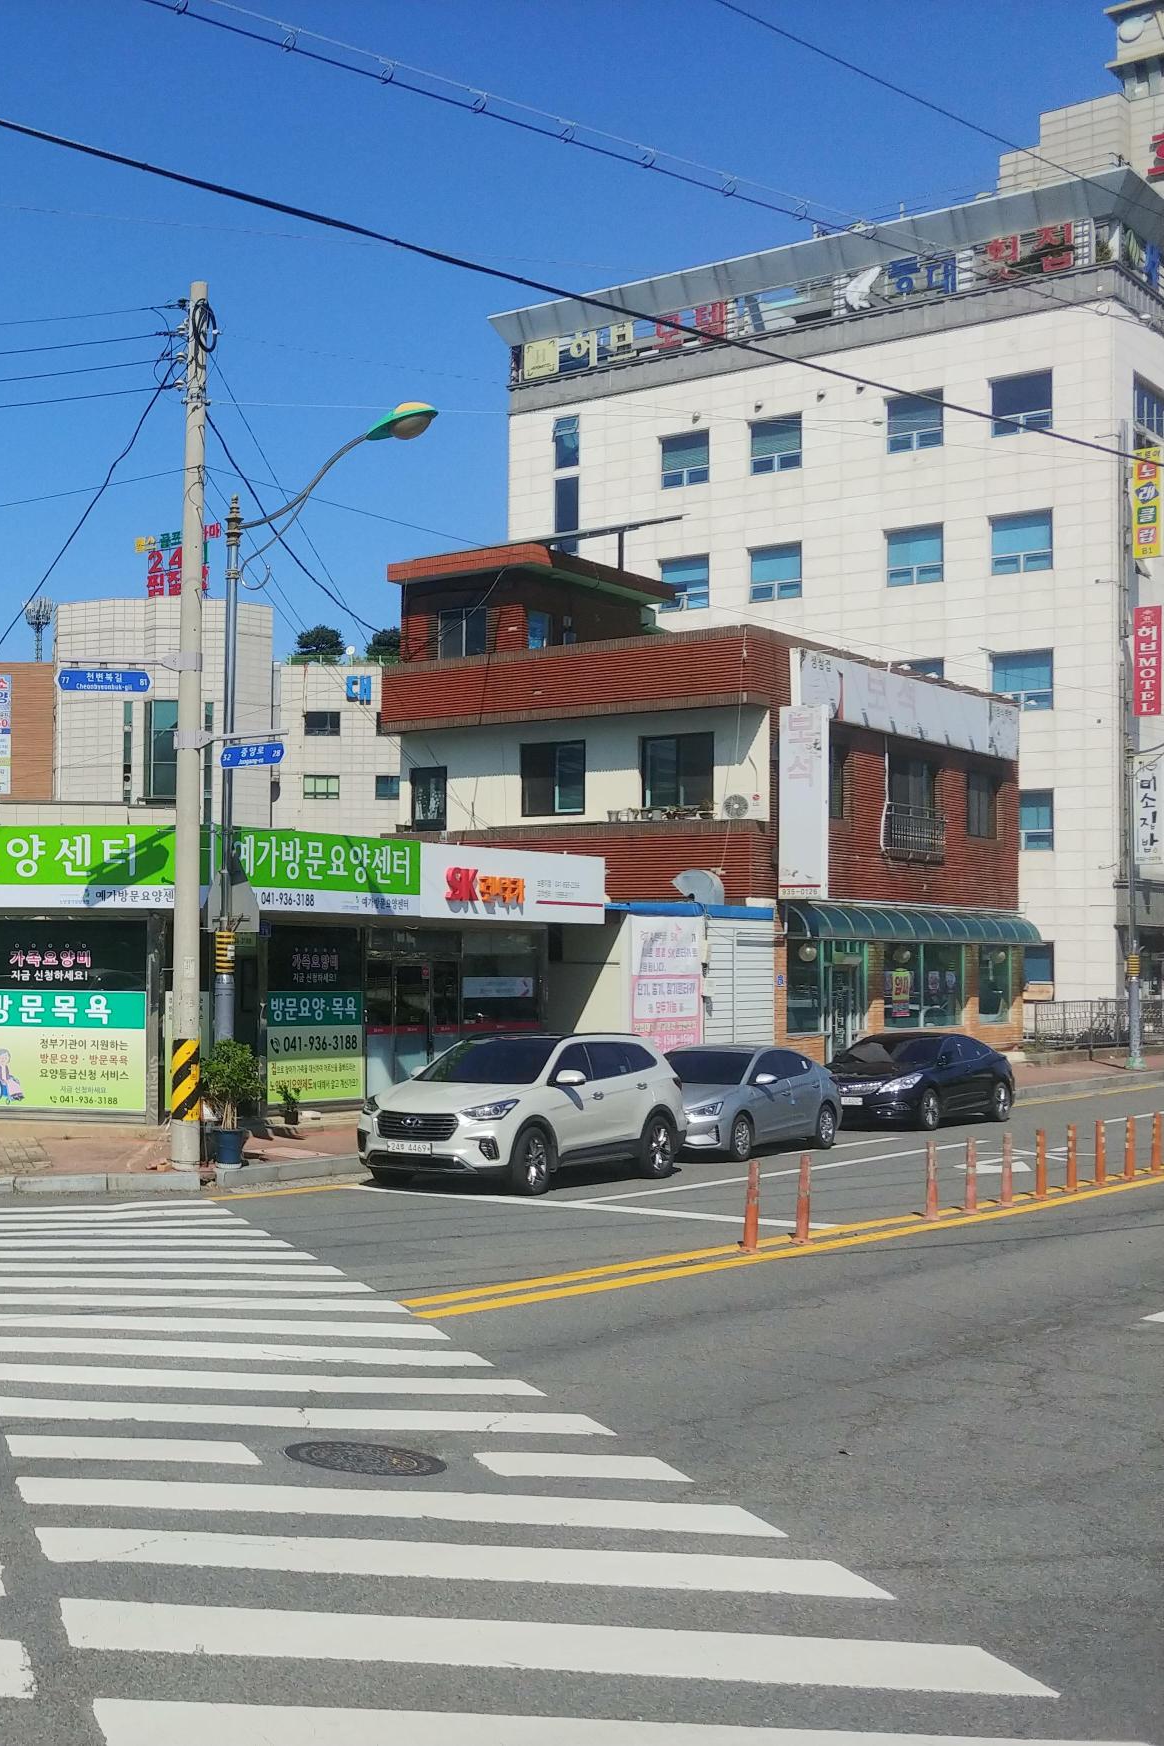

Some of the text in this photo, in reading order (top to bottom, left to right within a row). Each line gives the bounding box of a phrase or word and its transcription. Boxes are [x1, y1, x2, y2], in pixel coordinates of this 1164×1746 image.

[570, 301, 726, 368] 허브 모텔
[61, 676, 70, 685] 77
[86, 672, 123, 683] 천변북길
[1138, 657, 1157, 712] MOTEL
[233, 834, 411, 886] 예가방문요양센터
[95, 889, 174, 902] 예가방문요양센
[261, 891, 315, 907] 041-936-3188
[9, 950, 92, 967] 가족요양비
[10, 970, 89, 982] 지금 신청하세요!
[39, 1038, 129, 1051] 정부기관이 지원하는
[283, 1034, 358, 1052] 041-936-3188
[39, 1053, 129, 1066] 방문요양 방문목욕
[39, 1068, 129, 1081] 요양등급신청 서비스
[59, 1095, 118, 1105] 041-936-3188
[408, 1144, 427, 1153] 4469
